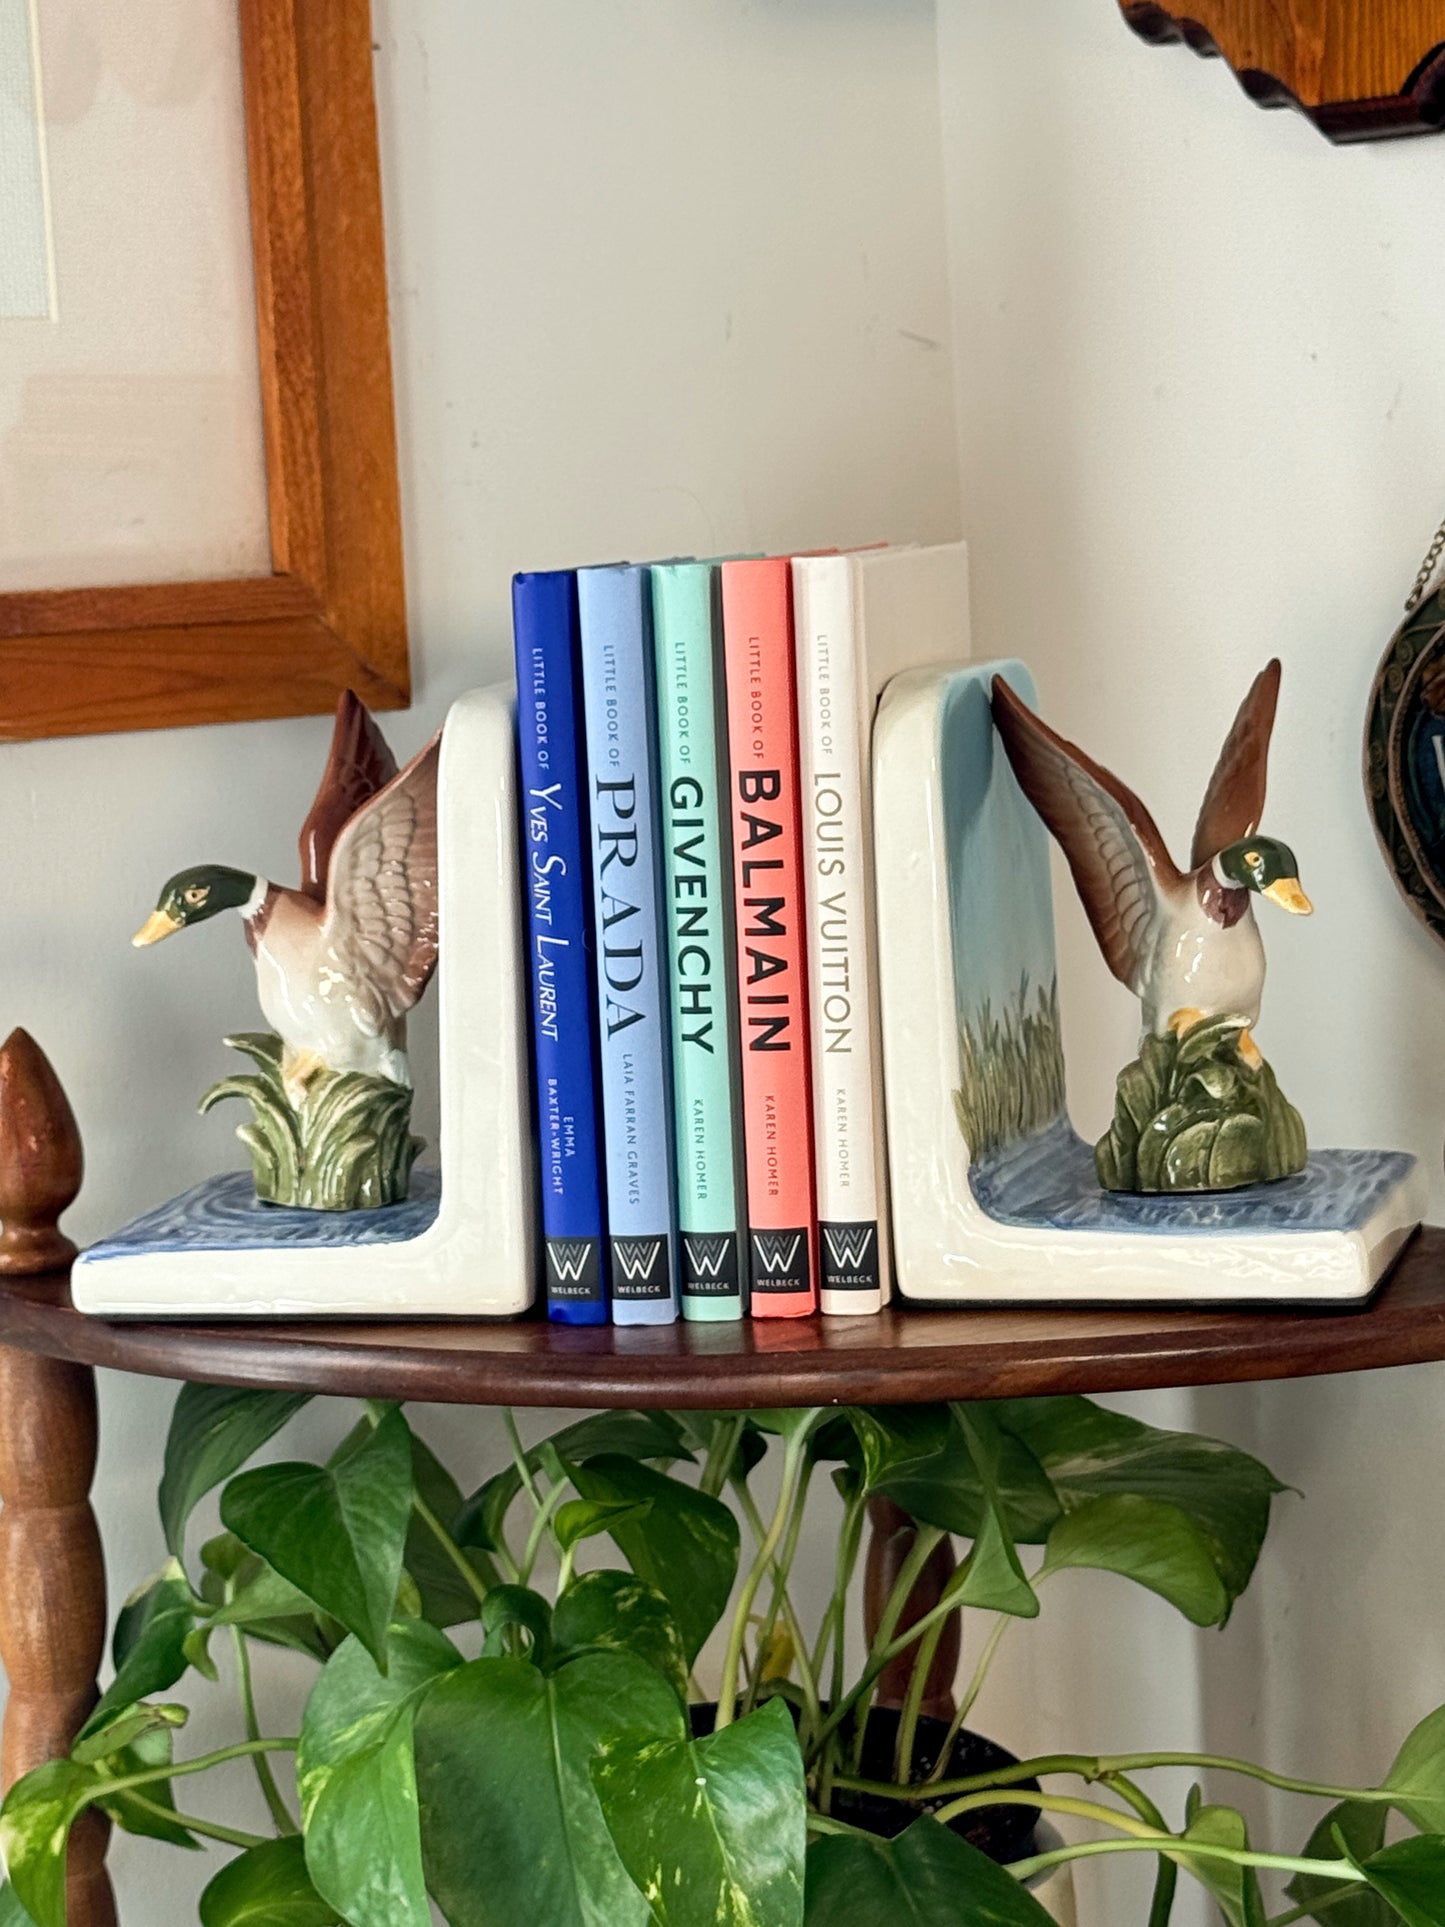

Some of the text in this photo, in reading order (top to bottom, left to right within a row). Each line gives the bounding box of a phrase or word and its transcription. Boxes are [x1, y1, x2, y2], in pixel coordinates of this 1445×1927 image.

[532, 648, 550, 770] LITTLE BOOK OF
[603, 644, 620, 767] LITTLE BOOK OF
[674, 641, 691, 764] LITTLE BOOK OF
[748, 636, 764, 759] LITTLE BOOK OF
[817, 634, 833, 755] LITTLE BOOK OF
[595, 772, 647, 1042] PRADA
[670, 776, 715, 1055] GIVENCHY
[738, 769, 791, 1052] BALMAIN
[814, 772, 852, 1053] LOUIS VUITTON
[548, 1078, 564, 1195] BAXTER-WRIGHT
[562, 1116, 576, 1158] EMMA
[622, 1053, 641, 1206] LAIA FARRAN GRAVES
[693, 1098, 708, 1201] KAREN HOMER
[764, 1094, 779, 1197] KAREN HOMER
[836, 1087, 850, 1188] KAREN HOMER
[551, 1286, 591, 1295] WELBECK
[617, 1285, 661, 1294] WELBECK
[688, 1281, 730, 1290] WELBECK
[757, 1278, 801, 1287] WELBECK
[827, 1274, 873, 1283] WELBECK
